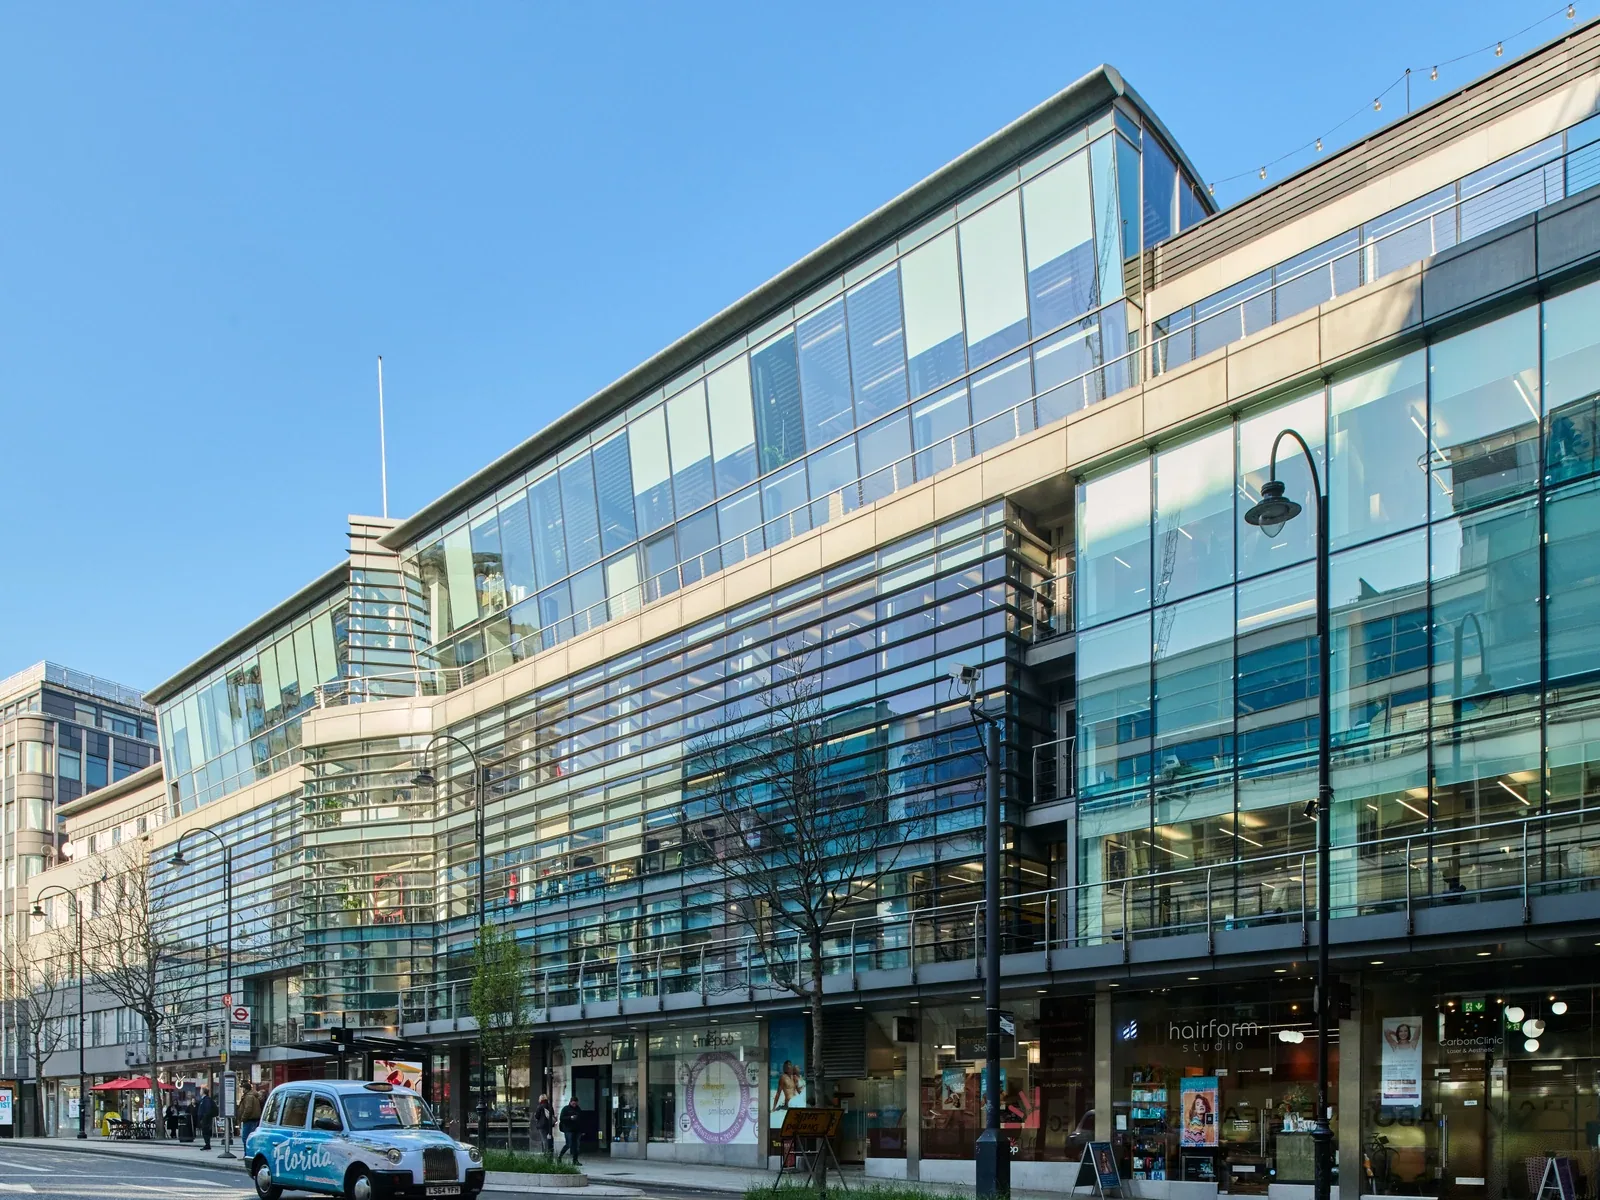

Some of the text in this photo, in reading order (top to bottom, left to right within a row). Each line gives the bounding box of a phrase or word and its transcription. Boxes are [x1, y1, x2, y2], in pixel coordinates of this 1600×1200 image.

[224, 996, 231, 1006] H
[1169, 1018, 1258, 1040] hairform
[1182, 1040, 1244, 1053] studio
[1439, 1036, 1504, 1047] CarbonClinic
[572, 1040, 611, 1062] smilepod
[973, 1043, 987, 1053] Sho
[428, 1187, 446, 1195] LS64
